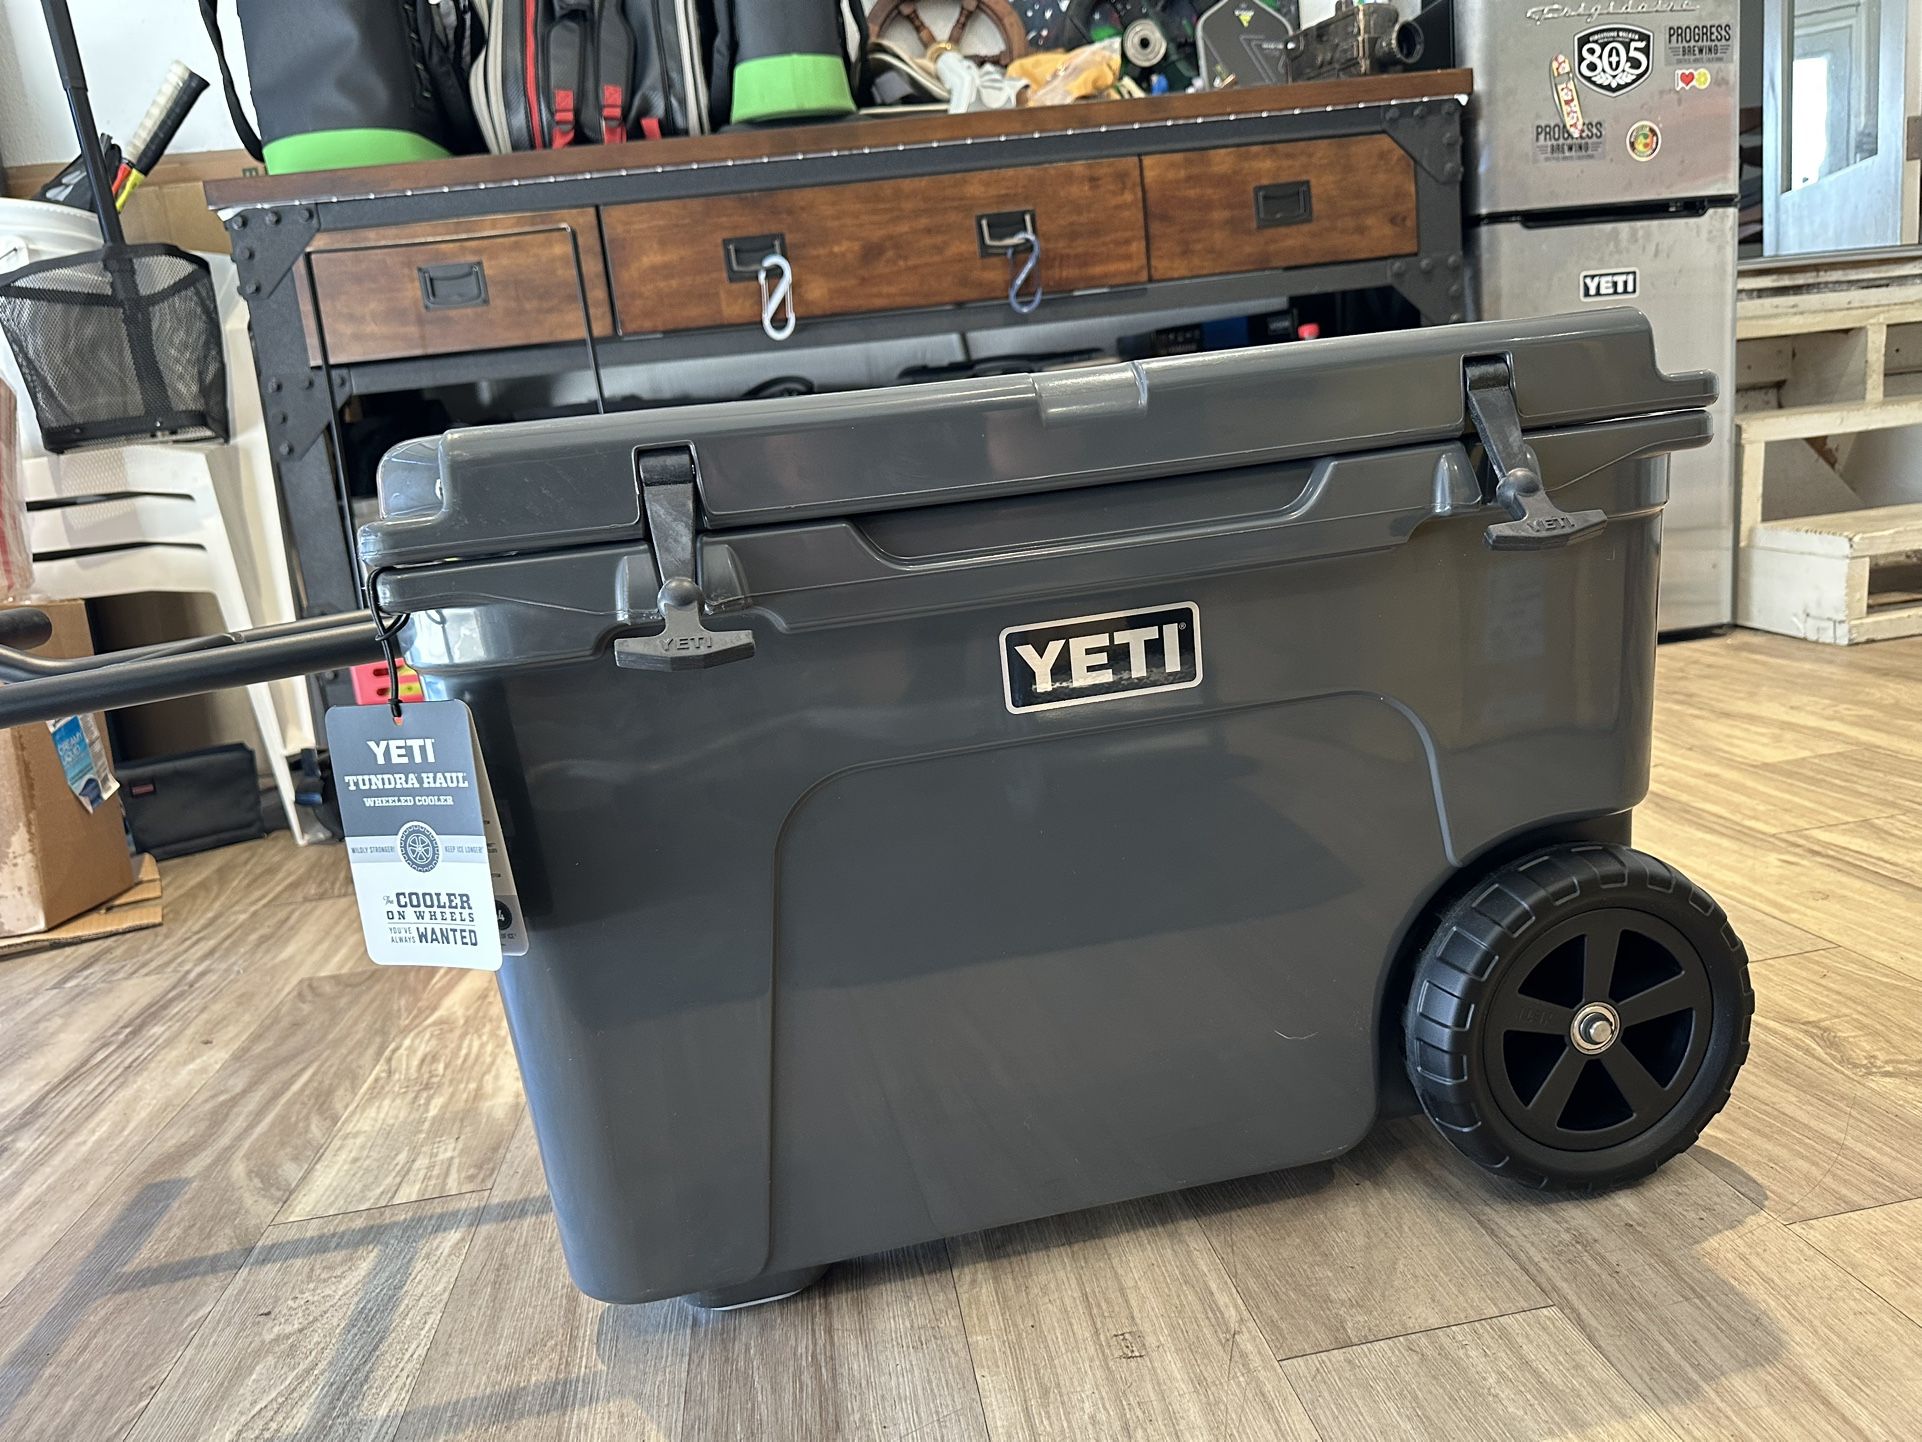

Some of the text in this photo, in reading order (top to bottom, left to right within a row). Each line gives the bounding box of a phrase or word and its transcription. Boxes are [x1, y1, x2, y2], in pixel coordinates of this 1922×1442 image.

[1668, 24, 1731, 44] PROGRESS
[1681, 44, 1719, 56] BREWING
[1579, 41, 1648, 77] 805
[1550, 142, 1589, 154] BREWING
[1584, 273, 1634, 296] YETI
[1527, 516, 1575, 532] YETI
[660, 636, 713, 651] YETI
[1014, 622, 1182, 693] YETI
[366, 738, 435, 764] YETI
[344, 772, 468, 790] TUNDRA HAUL
[363, 796, 454, 807] WHEELED COOLER
[382, 892, 472, 909] The COOLER
[386, 910, 475, 922] ON WHEELS
[388, 926, 478, 946] YOU'VE WANTED
